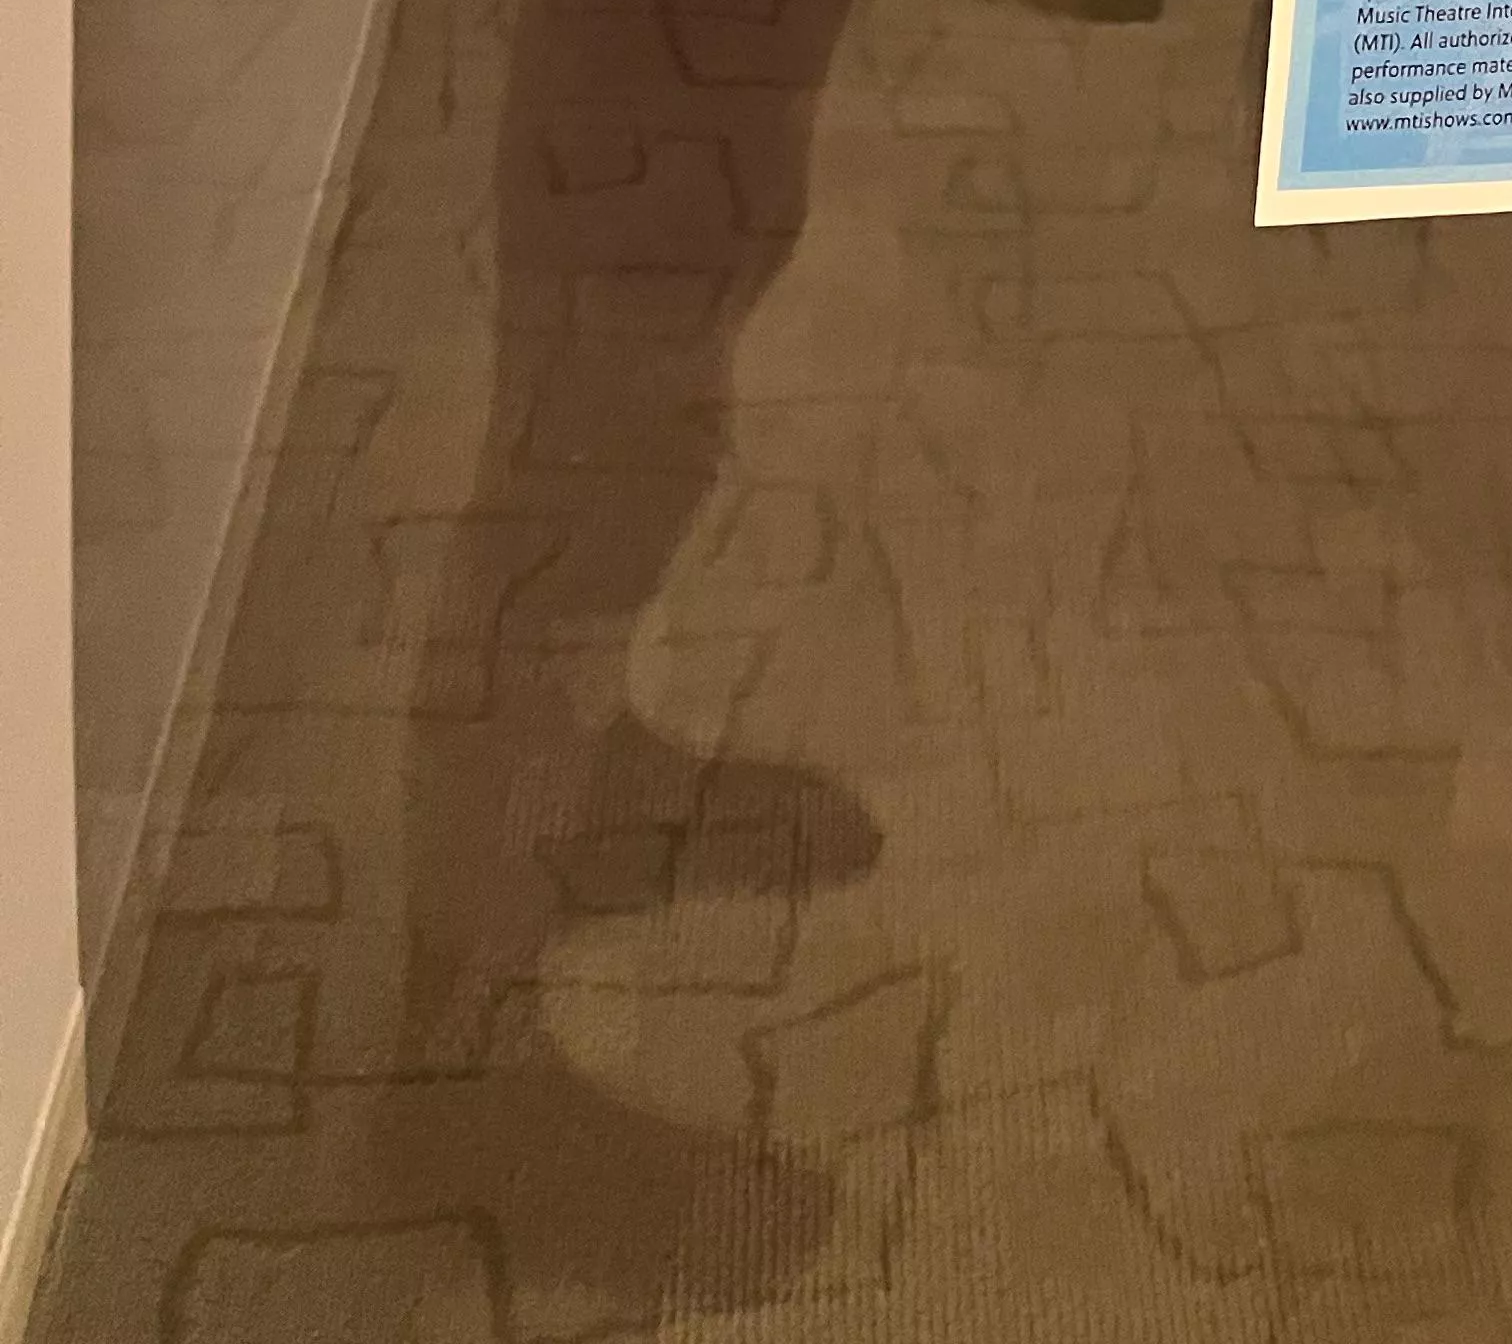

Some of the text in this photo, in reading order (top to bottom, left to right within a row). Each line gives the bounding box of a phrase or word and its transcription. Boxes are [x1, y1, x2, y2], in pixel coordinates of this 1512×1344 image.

[1357, 6, 1410, 25] Music
[1415, 3, 1482, 22] Theatre
[1354, 33, 1405, 54] (MTI).
[1410, 31, 1433, 50] All
[1351, 58, 1467, 84] performance
[1348, 89, 1385, 106] also
[1390, 84, 1467, 107] supplied
[1472, 83, 1493, 103] by
